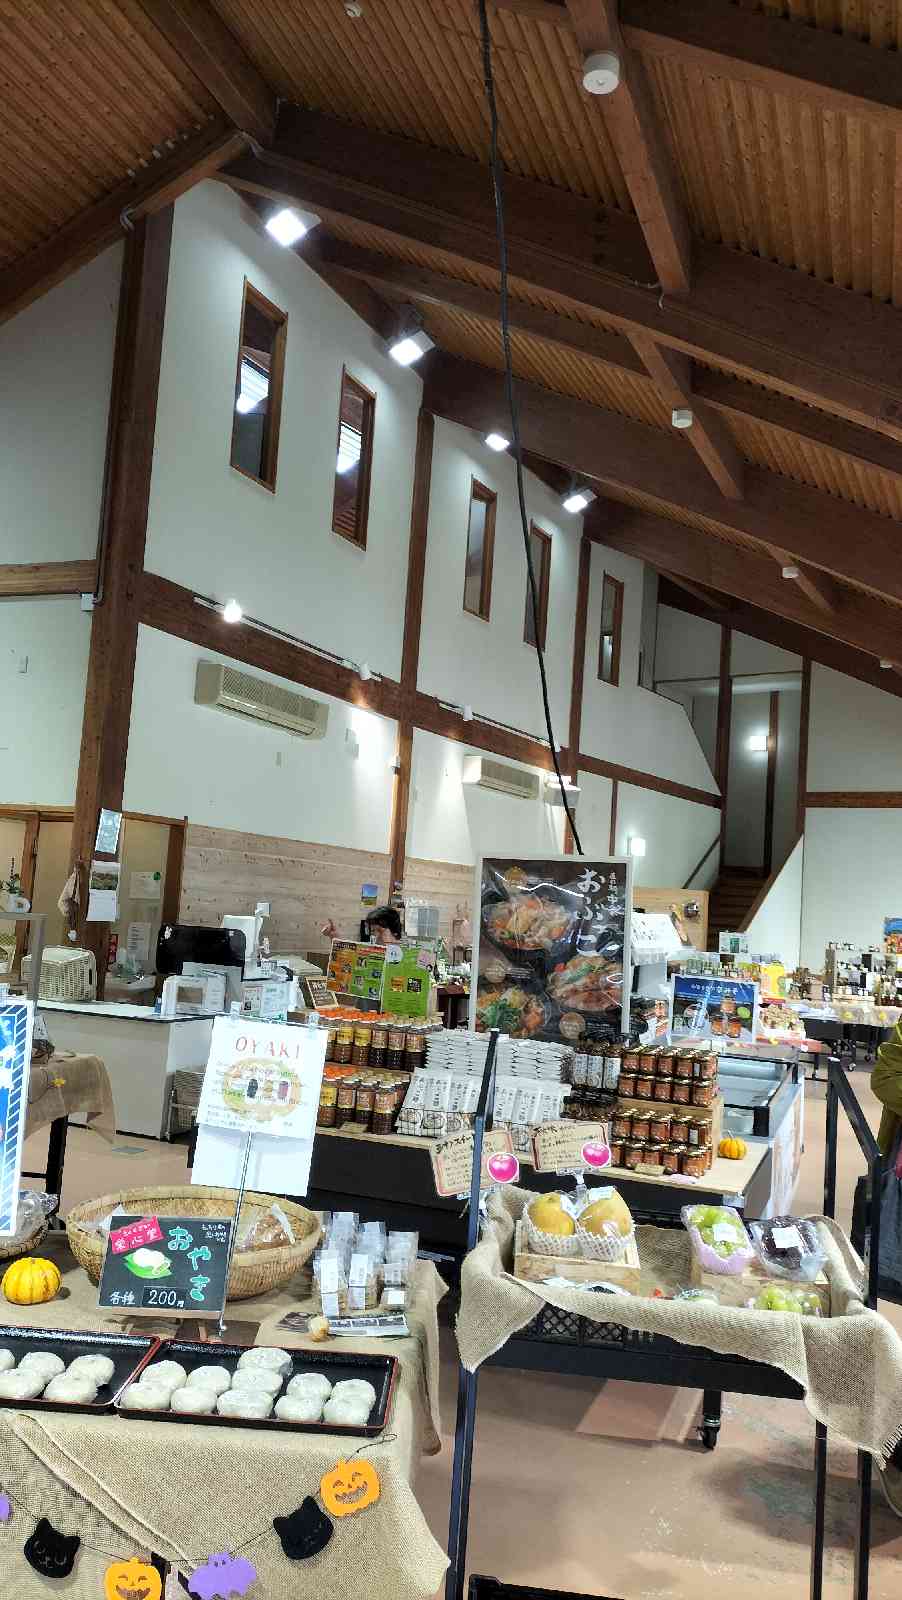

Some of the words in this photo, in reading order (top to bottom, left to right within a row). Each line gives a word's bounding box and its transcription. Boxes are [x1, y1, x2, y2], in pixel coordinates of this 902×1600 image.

[235, 1035, 300, 1059] OYAKI
[167, 1225, 212, 1302] おやき
[109, 1289, 136, 1305] 各種
